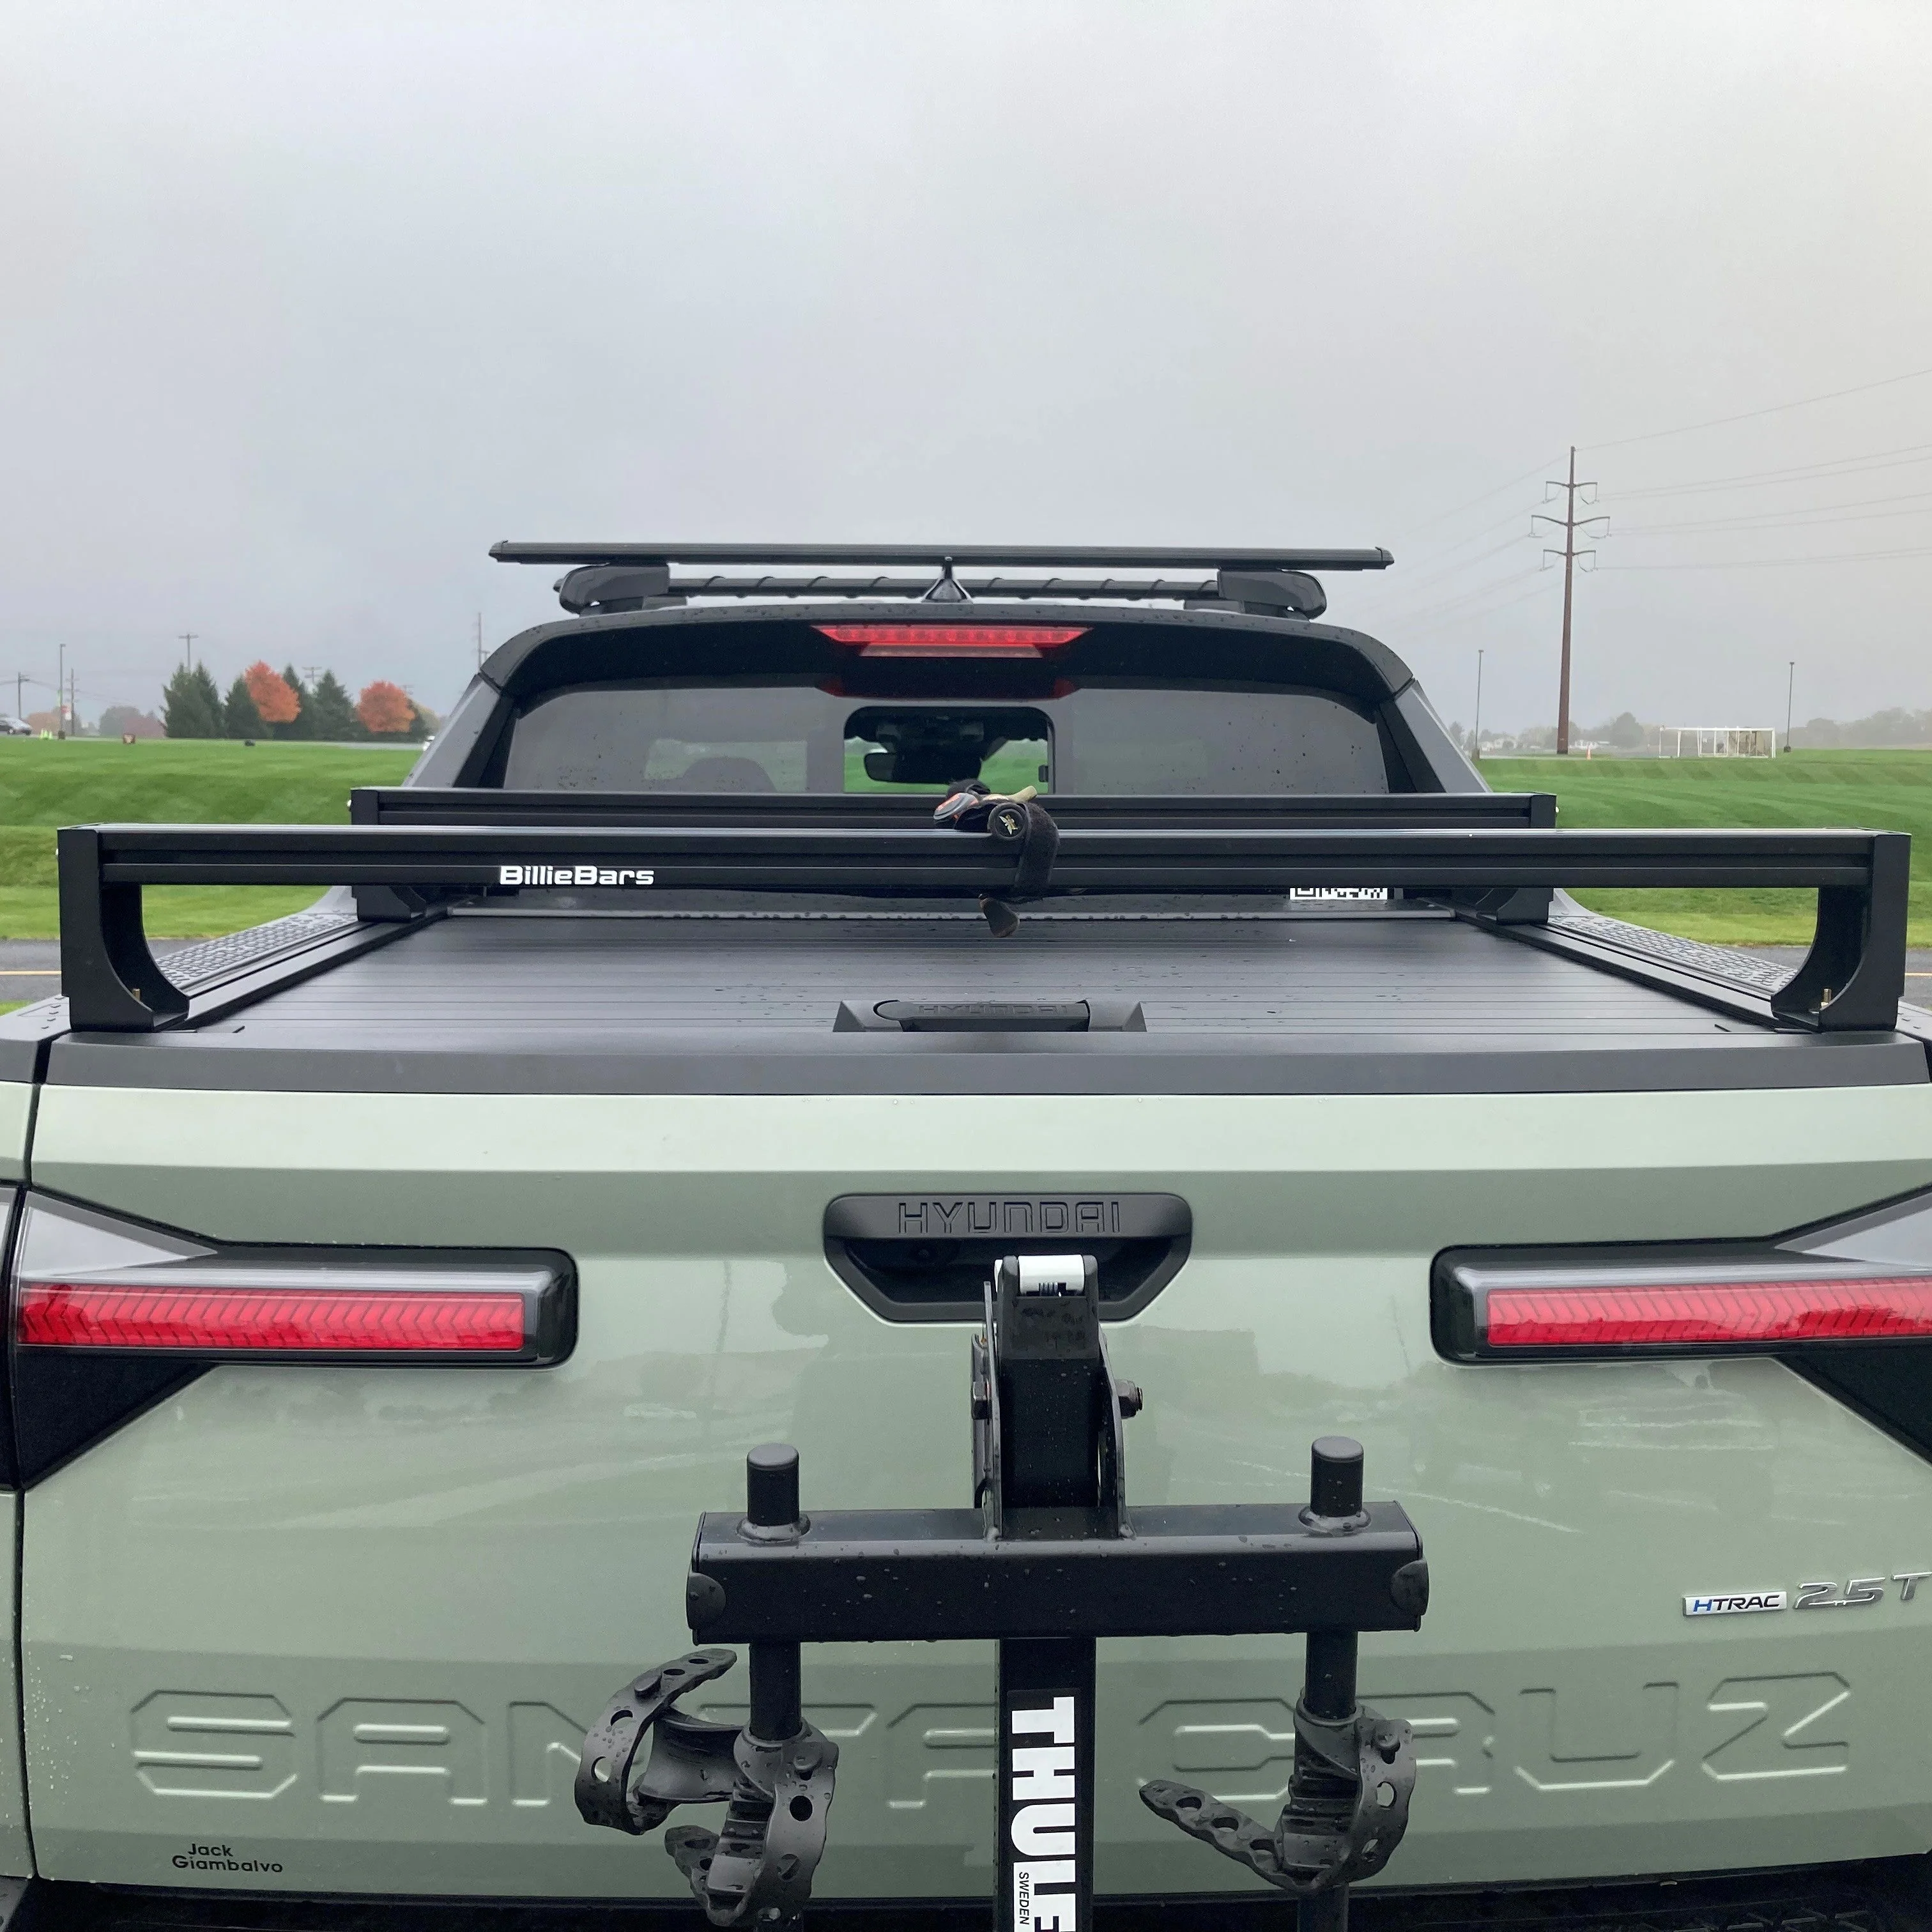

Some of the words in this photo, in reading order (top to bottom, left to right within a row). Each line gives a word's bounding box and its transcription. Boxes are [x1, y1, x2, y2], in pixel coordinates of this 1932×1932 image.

[500, 866, 654, 885] BillieBars
[918, 1004, 1068, 1015] HYUNDAI
[898, 1201, 1121, 1234] HYUNDAI
[1692, 1595, 1780, 1613] HTRAC
[1011, 1696, 1076, 1932] THULE
[187, 1843, 233, 1857] Jack
[171, 1855, 283, 1873] Giambalvo
[1018, 1871, 1030, 1926] SWEDEN
